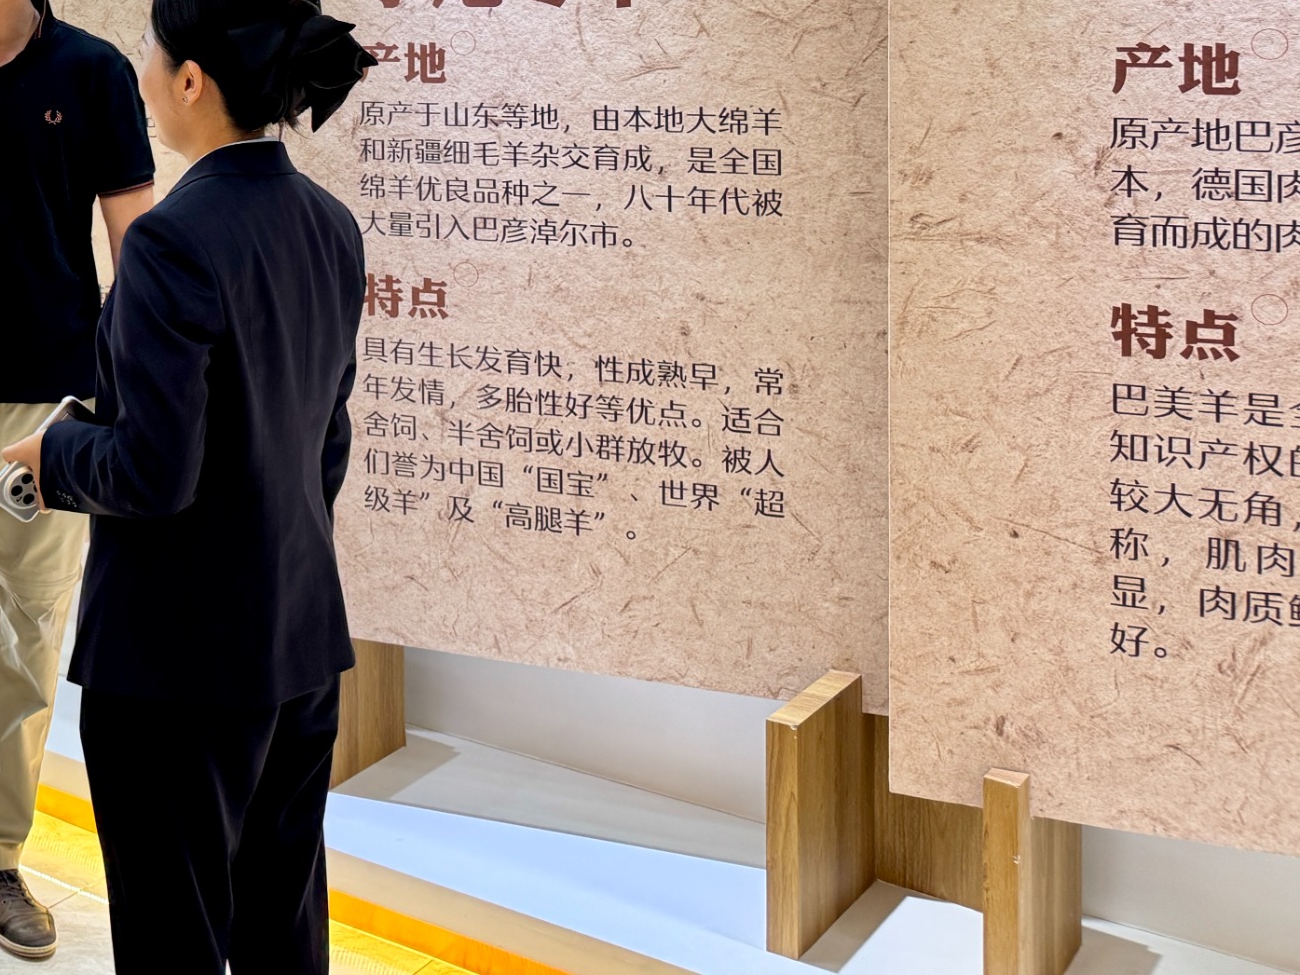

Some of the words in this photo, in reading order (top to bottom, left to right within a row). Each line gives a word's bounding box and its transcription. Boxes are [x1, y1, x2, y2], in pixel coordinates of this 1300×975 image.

[360, 41, 447, 83] 产地
[1112, 42, 1242, 96] 产地
[359, 100, 783, 136] 原产于山东等地，由本地大绵羊
[359, 138, 783, 177] 和新疆细毛羊杂交育成，是全国
[359, 174, 784, 218] 绵羊优良品种之一，八十年代被
[359, 210, 636, 249] 大量引入巴彦淖尔市。
[364, 273, 449, 320] 特点
[1110, 302, 1240, 362] 特点
[362, 336, 784, 396] 具有生长发育快，性成熟早，常
[362, 373, 785, 437] 年发情，多胎性好等优点。适合
[1109, 429, 1300, 477] 知识产权
[1109, 527, 1295, 577] 称，肌肉
[1110, 622, 1167, 659] 好。
